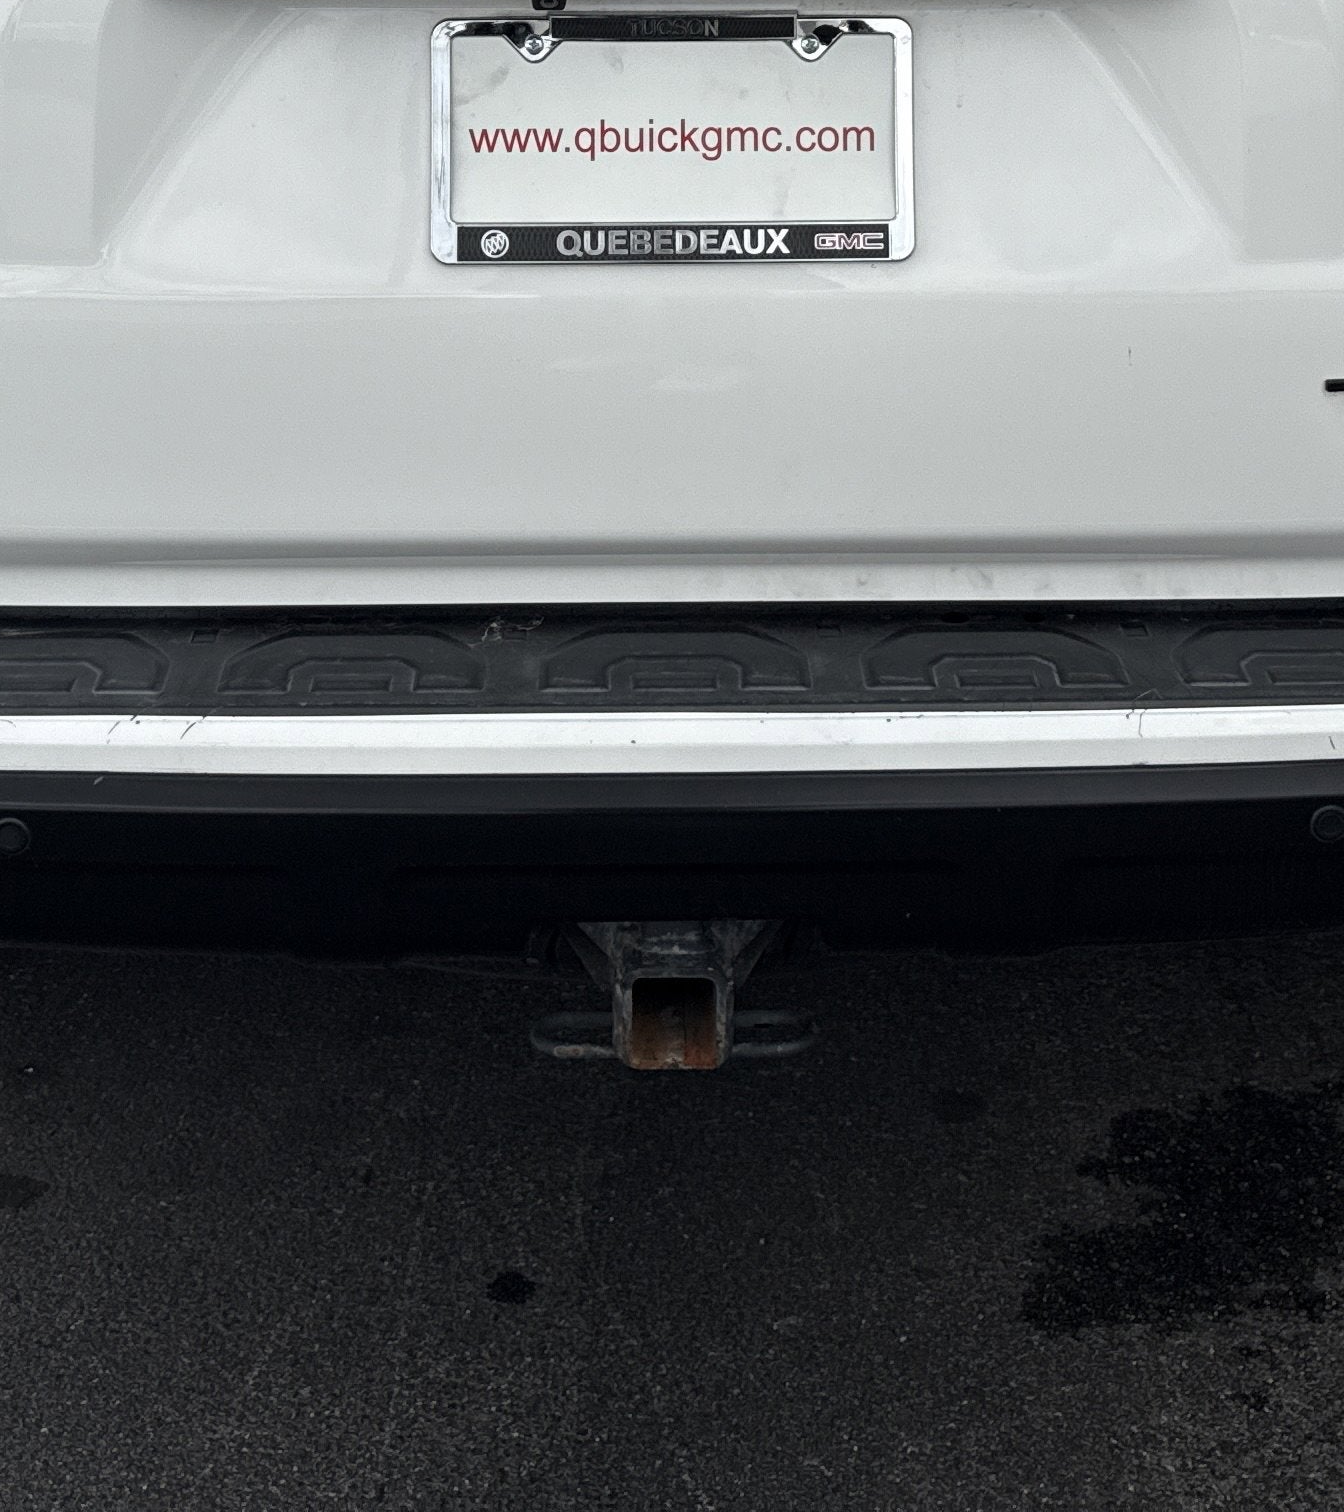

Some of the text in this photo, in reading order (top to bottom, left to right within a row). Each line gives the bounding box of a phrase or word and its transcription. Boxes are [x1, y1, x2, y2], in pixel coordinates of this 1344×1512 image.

[630, 19, 719, 38] TUCSON
[468, 119, 876, 161] www.qbuickgmc.com
[556, 229, 885, 257] QUEBEDEAUX GMC
